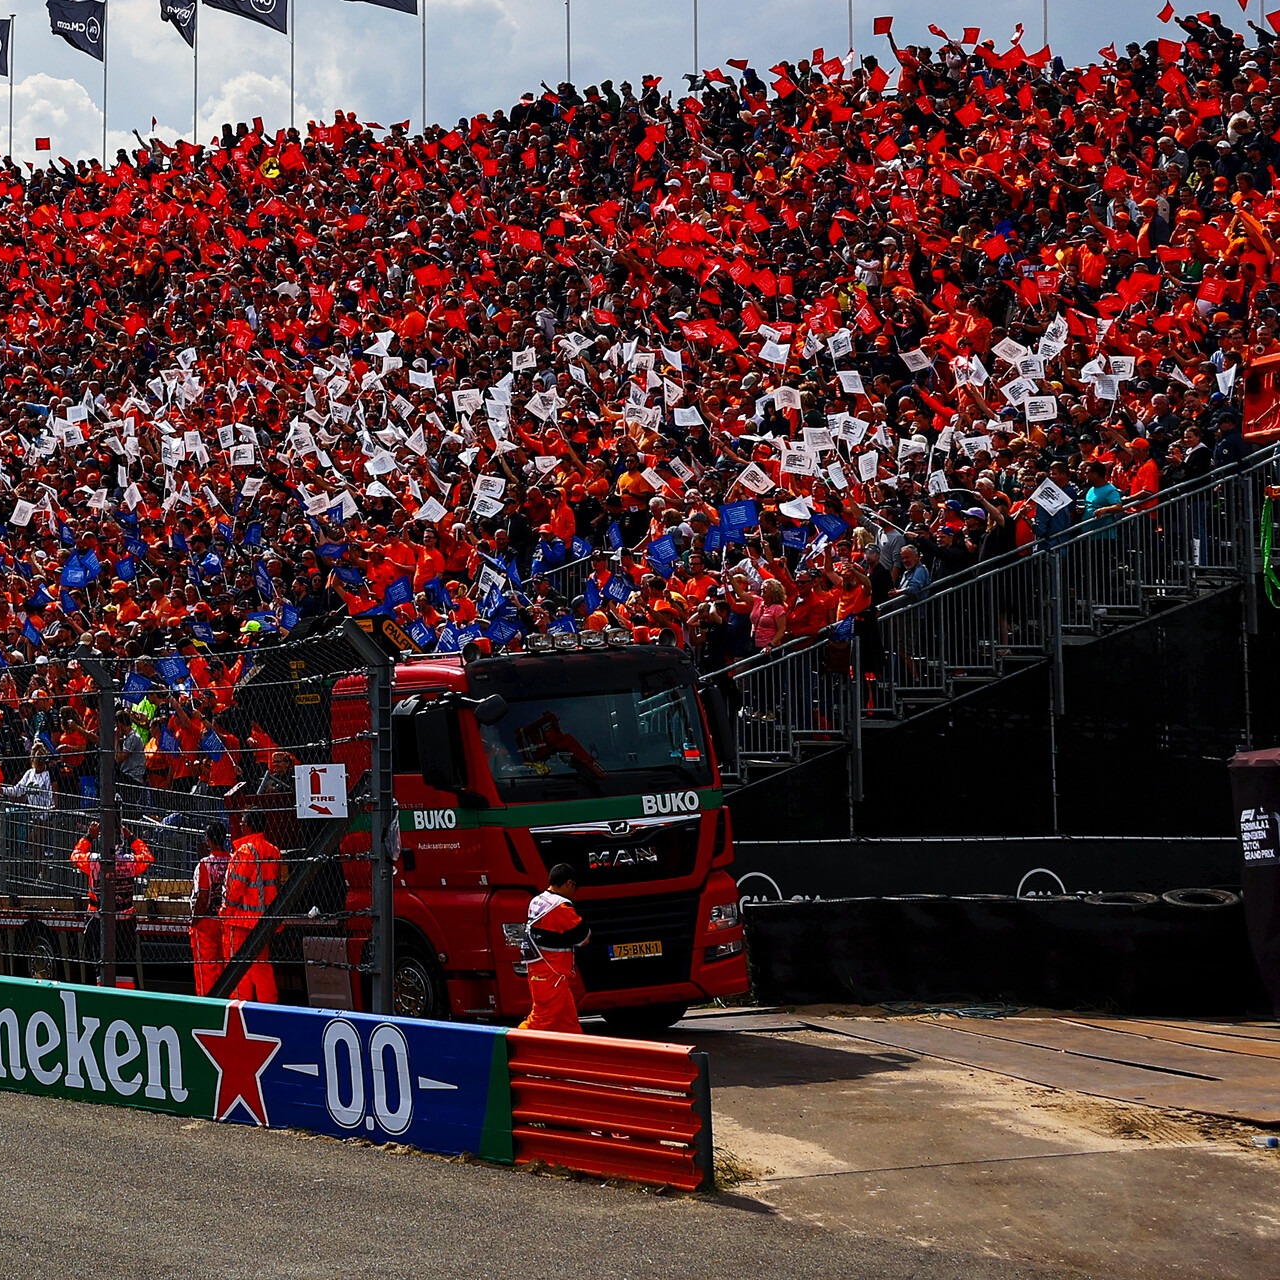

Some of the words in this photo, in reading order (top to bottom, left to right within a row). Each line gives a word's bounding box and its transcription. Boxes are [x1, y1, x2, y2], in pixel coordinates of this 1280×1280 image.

[642, 791, 699, 815] BUKO
[413, 809, 456, 830] BUKO
[588, 847, 658, 868] MAN
[323, 1018, 415, 1136] 0.0
